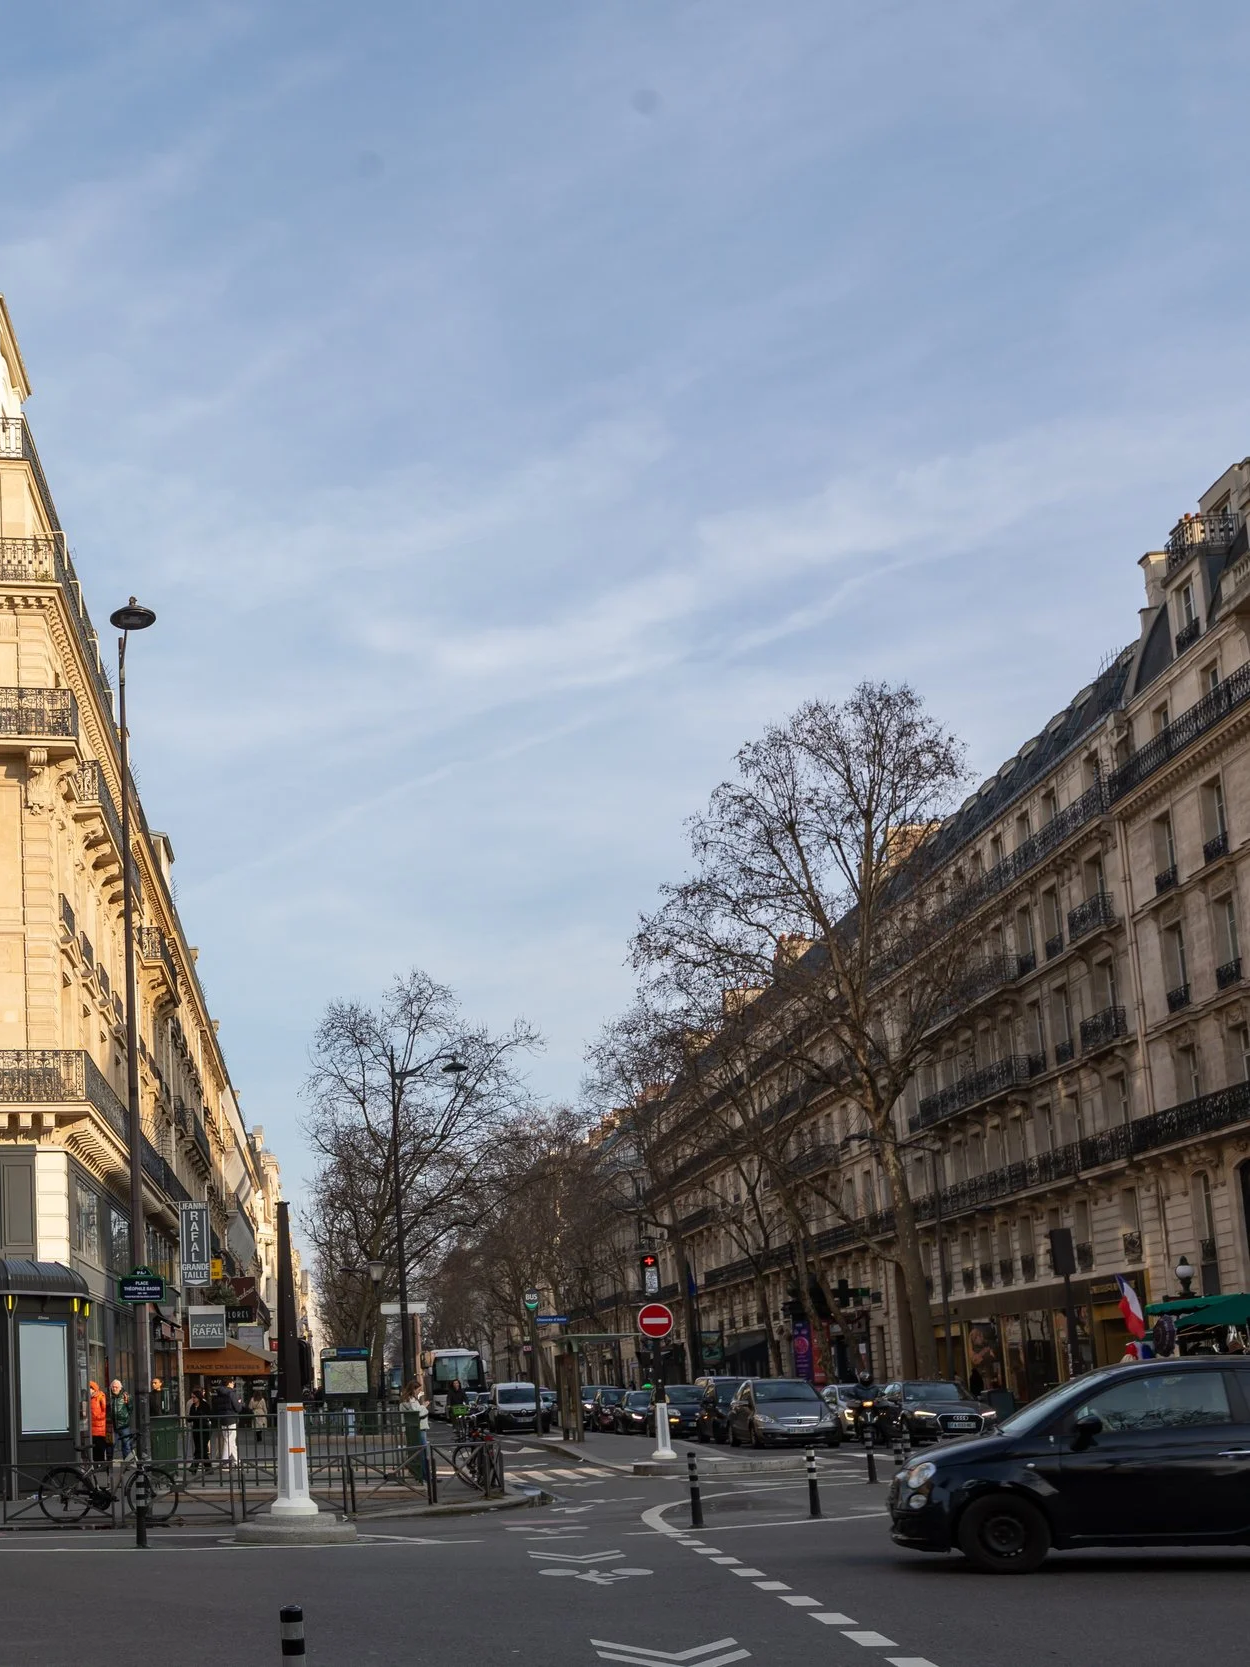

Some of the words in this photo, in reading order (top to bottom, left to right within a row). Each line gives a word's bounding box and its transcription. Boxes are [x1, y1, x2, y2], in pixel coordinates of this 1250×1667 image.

[180, 1202, 207, 1210] JEANNE
[190, 1211, 199, 1262] RAFAL
[182, 1263, 210, 1271] GRANDE
[183, 1271, 208, 1279] TAILLE
[225, 1310, 249, 1319] LORES
[192, 1327, 224, 1336] RAFAL
